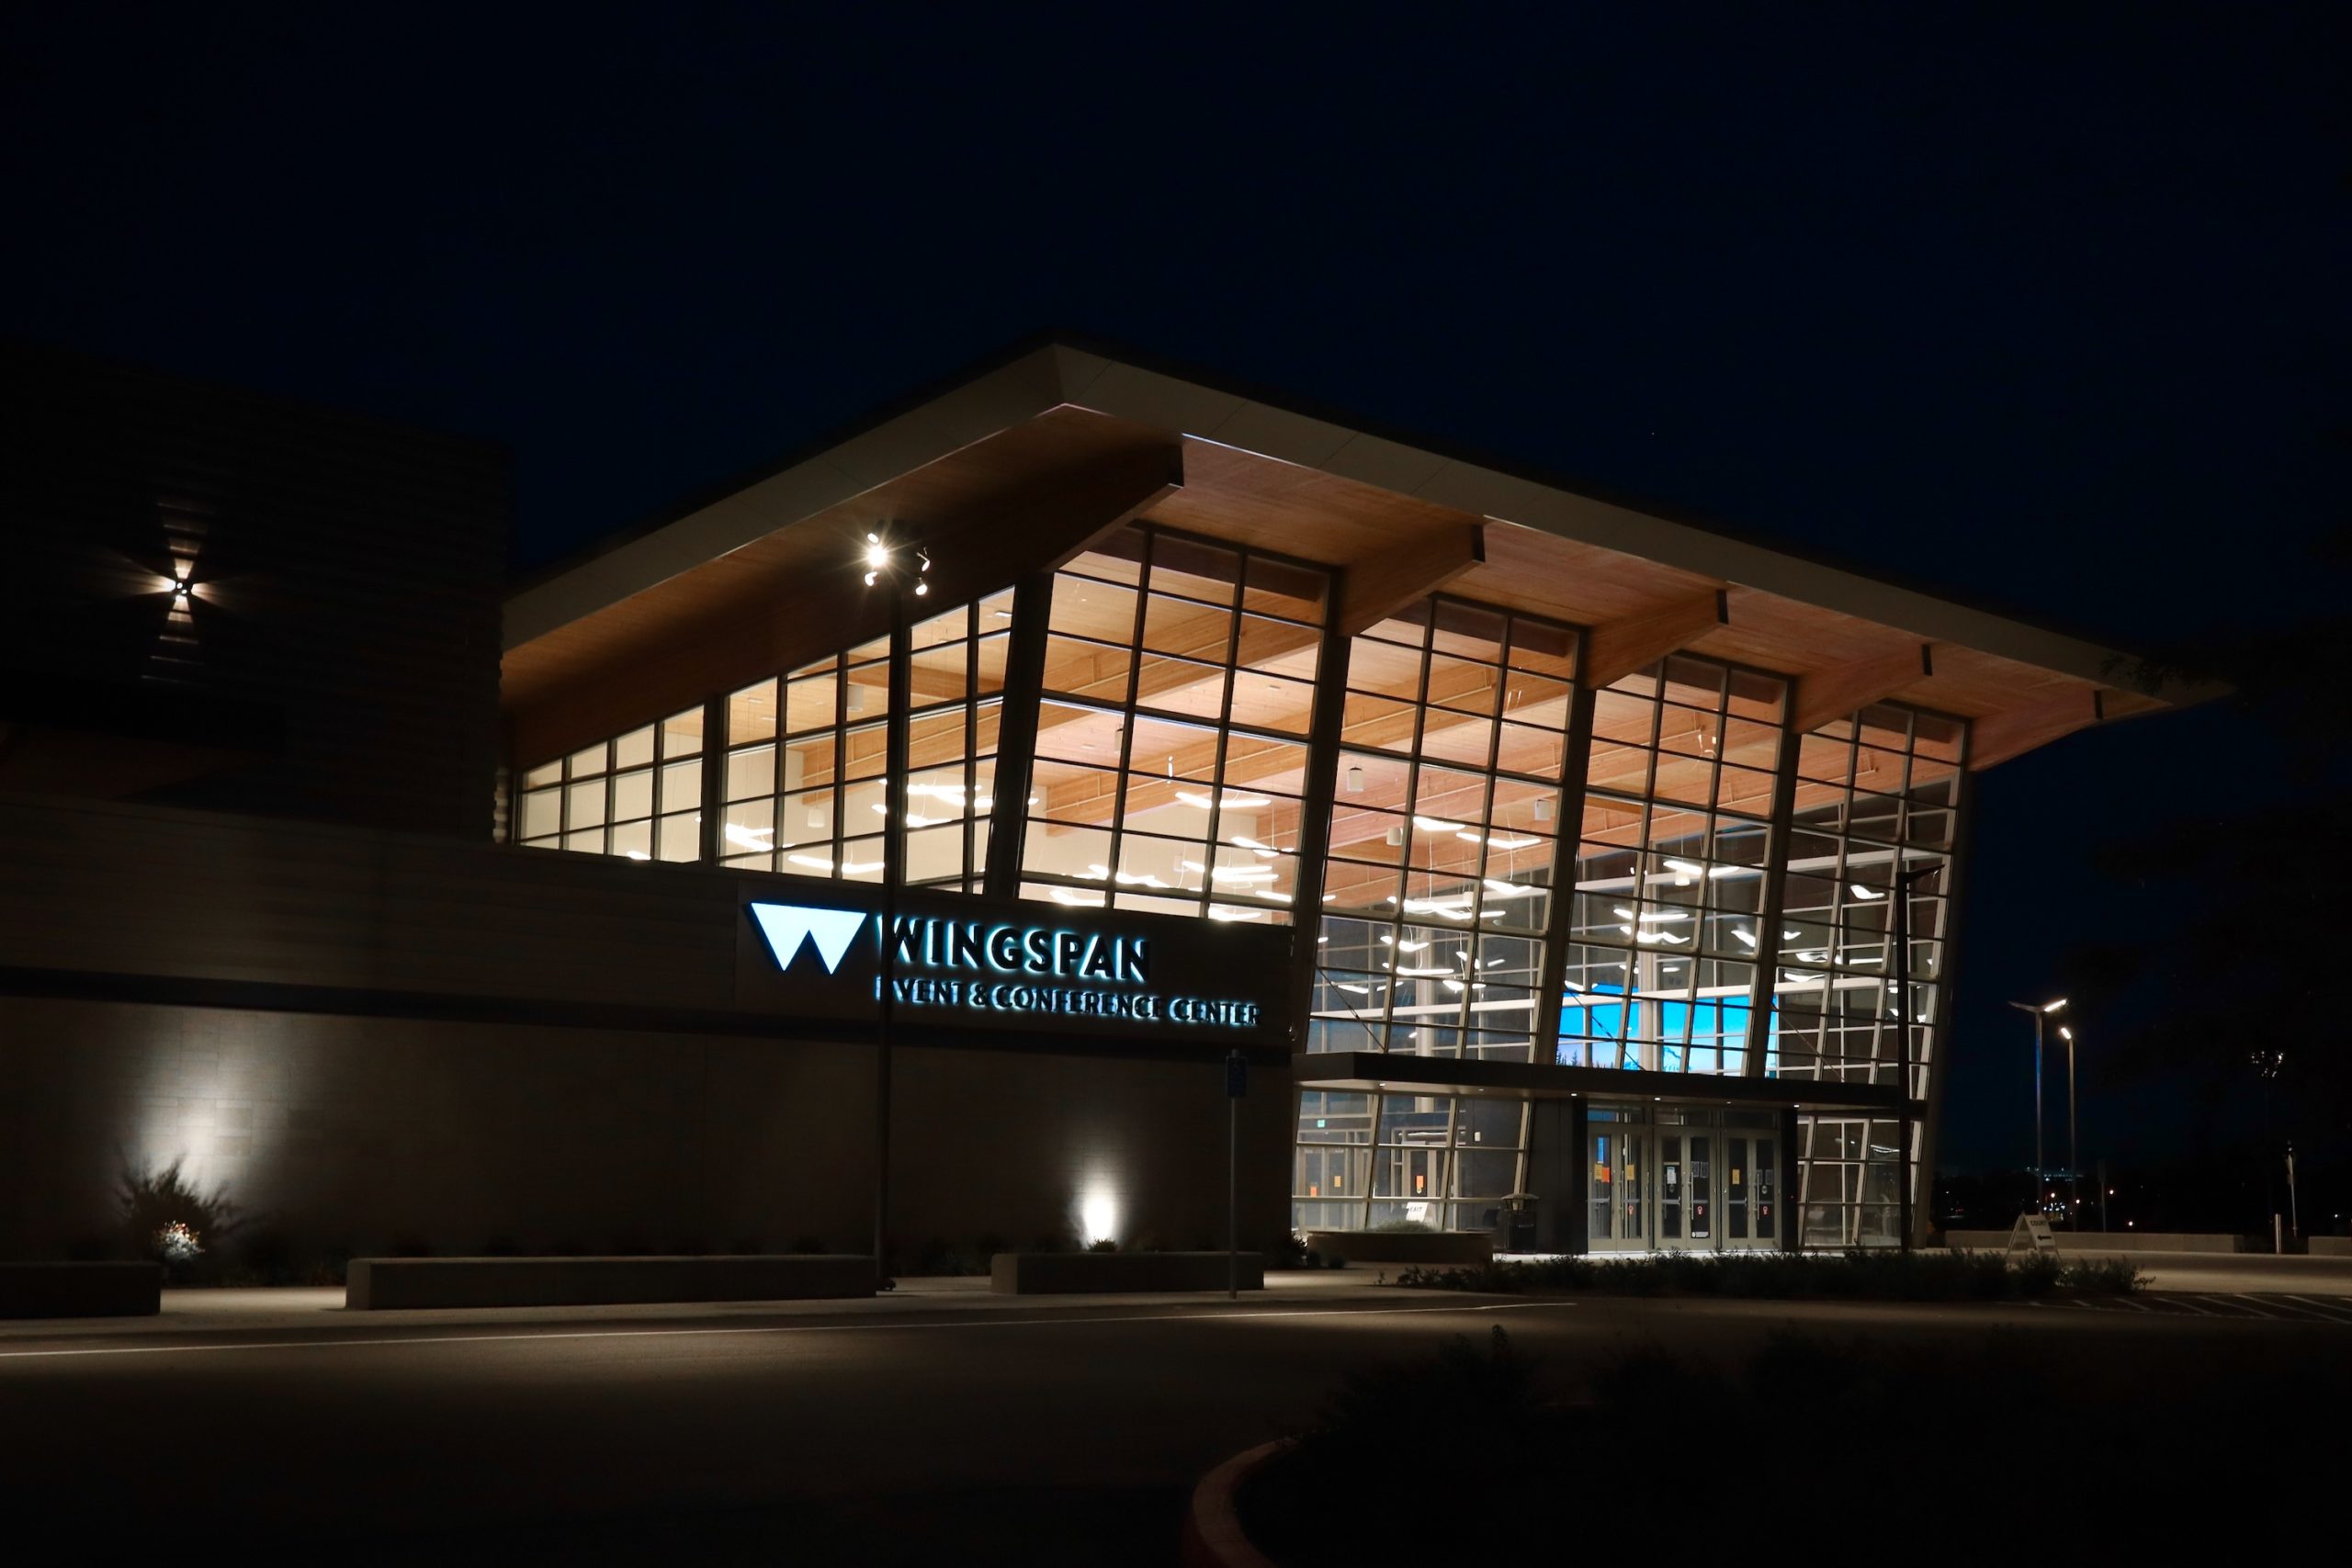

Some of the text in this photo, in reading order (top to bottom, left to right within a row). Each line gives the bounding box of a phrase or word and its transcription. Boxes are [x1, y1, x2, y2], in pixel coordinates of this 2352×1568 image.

[876, 915, 1148, 983] WINGSPAN
[876, 976, 1261, 1026] VENT & CONFERENCE CENTER
